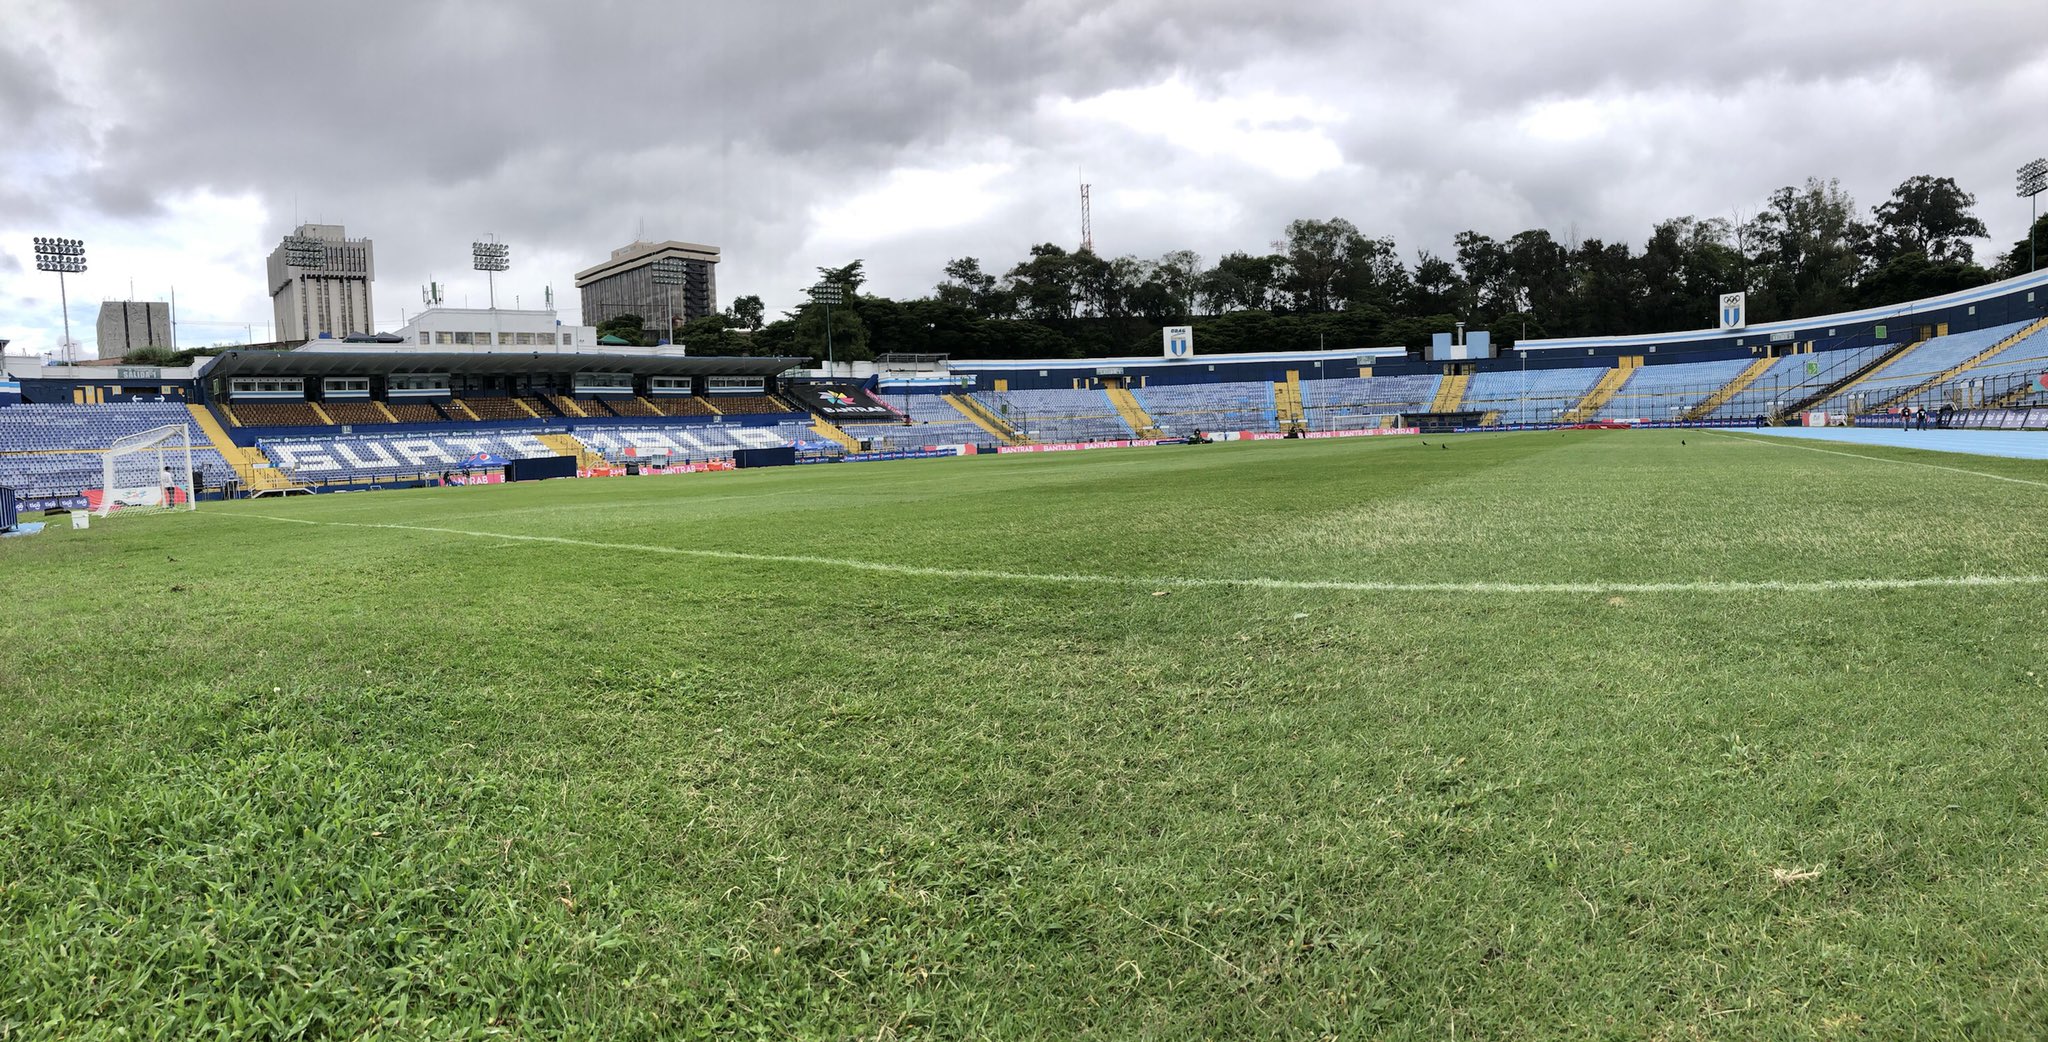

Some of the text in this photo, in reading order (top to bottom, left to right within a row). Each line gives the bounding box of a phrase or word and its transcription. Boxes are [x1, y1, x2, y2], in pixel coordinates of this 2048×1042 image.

[1001, 446, 1034, 454] BANTRAB
[1043, 444, 1077, 452] BANTRAB
[1084, 441, 1118, 449] BANTRAB
